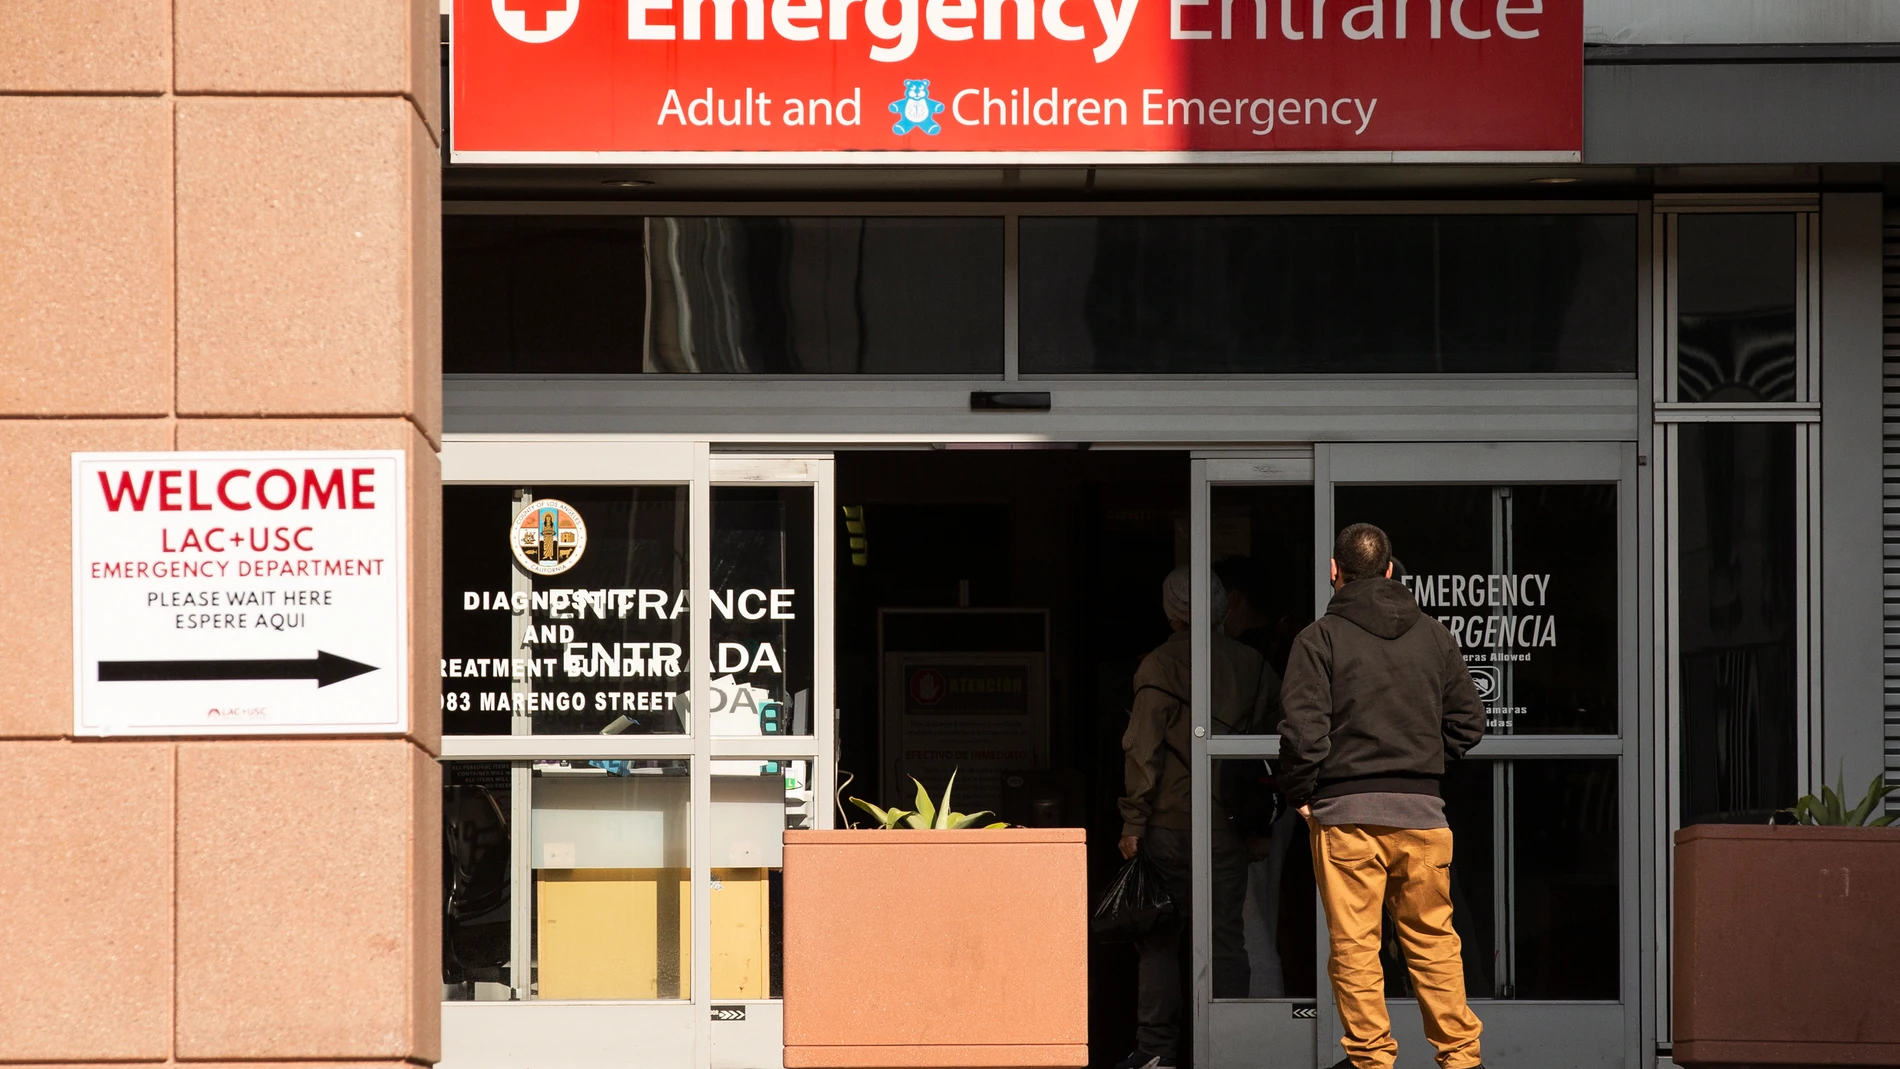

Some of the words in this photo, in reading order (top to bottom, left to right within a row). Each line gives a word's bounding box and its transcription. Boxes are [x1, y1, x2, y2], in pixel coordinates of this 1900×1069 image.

[627, 0, 1139, 63] Emergency
[1169, 0, 1543, 40] Entrance
[656, 87, 772, 126] Adult
[782, 87, 861, 126] and
[951, 86, 1128, 126] Children
[1142, 88, 1378, 136] Emergency
[97, 468, 376, 512] WELCOME
[516, 506, 535, 525] COUNTY
[560, 505, 581, 525] ANGELES
[161, 526, 315, 553] LAC+USC
[91, 560, 230, 579] EMERGENCY
[238, 559, 385, 578] DEPARTMENT
[531, 564, 566, 573] CALIFORNIA
[147, 591, 220, 607] PLEASE
[226, 591, 277, 606] WAIT
[284, 590, 333, 606] HERE
[463, 591, 636, 611] DIAGNOSTIC
[548, 588, 795, 620] ENTRANCE
[175, 613, 248, 629] ESPERE
[254, 612, 306, 632] AQUI
[1436, 615, 1557, 648] RGENCIA
[523, 624, 575, 644] AND
[563, 642, 783, 673] ENTRDA
[1462, 654, 1488, 662] eras
[1490, 652, 1531, 662] Allowed
[440, 658, 558, 678] REATMENT
[567, 658, 680, 678] BUILDING
[440, 691, 471, 712] 83
[480, 691, 586, 712] MARENGO
[594, 691, 677, 711] STREET
[1485, 703, 1528, 714] ámaras
[906, 750, 953, 760] EFECTIVO
[955, 750, 970, 760] DE
[971, 750, 1027, 760] INMEDIATO
